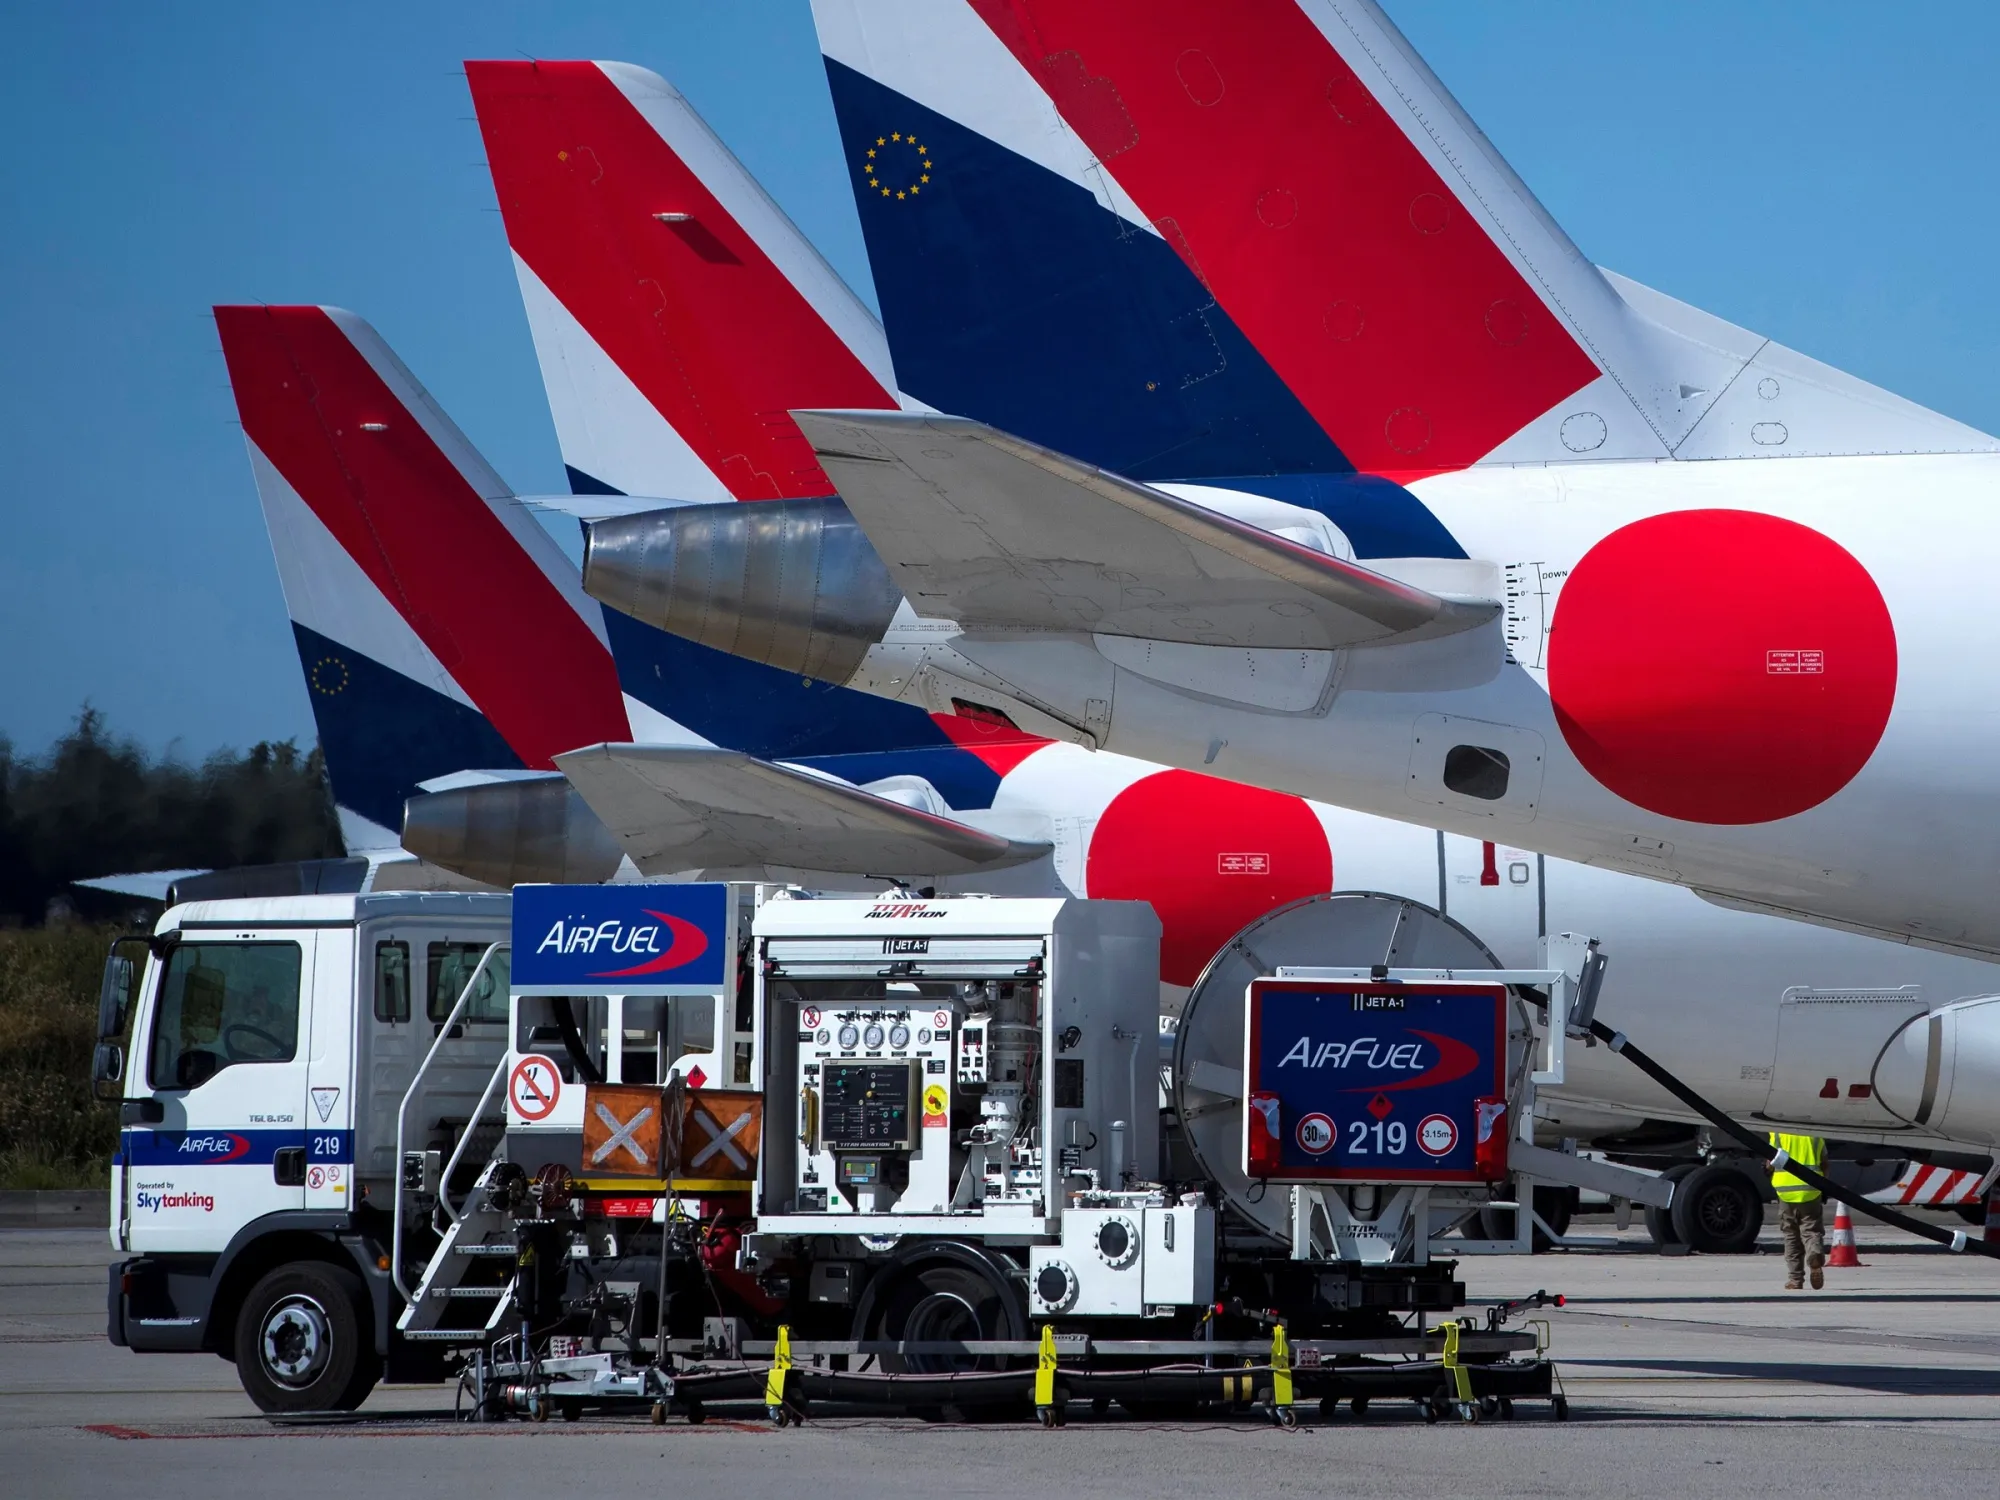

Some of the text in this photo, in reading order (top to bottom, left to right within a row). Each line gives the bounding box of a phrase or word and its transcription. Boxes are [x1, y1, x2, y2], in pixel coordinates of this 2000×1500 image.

[1542, 570, 1568, 580] DOWN
[536, 920, 660, 954] AIRFUEL
[895, 940, 927, 950] JET A-1
[1365, 997, 1405, 1008] JET A-1
[1277, 1036, 1424, 1069] AIRFUEL
[249, 1114, 294, 1123] TGL 8.150
[1304, 1125, 1318, 1142] 30
[1348, 1121, 1407, 1154] 219
[1424, 1130, 1449, 1139] 3.15m
[178, 1137, 231, 1153] AIRFUEL
[314, 1136, 340, 1155] 219
[137, 1181, 174, 1190] Operated by
[137, 1192, 214, 1212] Skytanking
